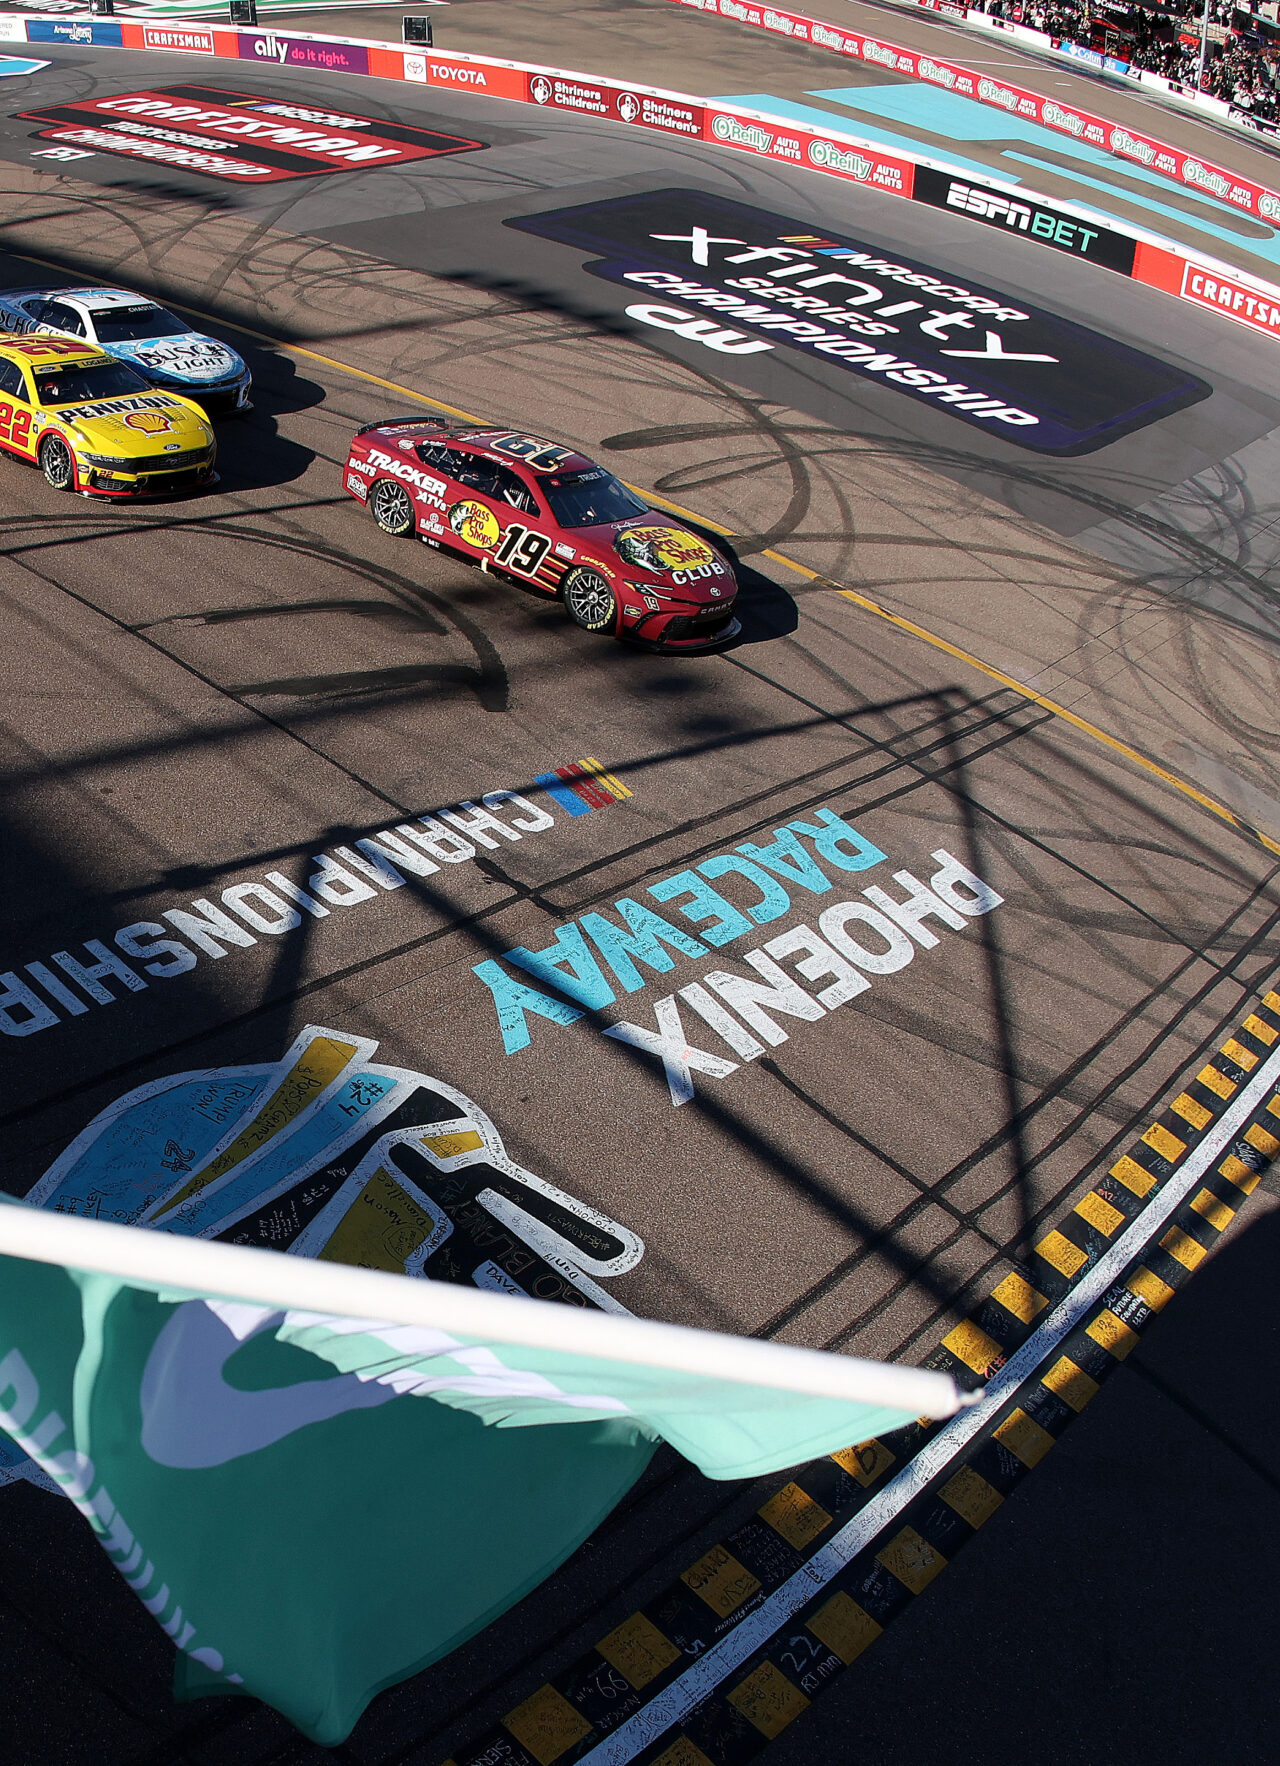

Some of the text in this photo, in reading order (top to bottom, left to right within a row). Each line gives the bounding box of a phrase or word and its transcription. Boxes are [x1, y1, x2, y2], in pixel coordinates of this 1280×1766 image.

[254, 36, 289, 64] ally
[291, 48, 349, 67] do it right.
[430, 64, 486, 86] TOYOTA
[554, 82, 601, 101] Shriners
[979, 80, 1018, 109] O'Reilly
[554, 93, 607, 114] Children's
[642, 100, 692, 120] Shriners
[1018, 106, 1037, 118] PARTS
[1020, 98, 1036, 110] AUTO
[96, 97, 402, 162] CRAFTSMAN
[642, 112, 698, 134] Children's
[1042, 104, 1084, 134] O'Reilly
[1087, 124, 1104, 135] AUTO
[713, 115, 771, 152] O'Reilly
[776, 136, 799, 149] AUTO
[1085, 131, 1104, 144] PARTS
[52, 126, 271, 177] CHAMPIONSHIP
[773, 145, 801, 160] PARTS
[1111, 130, 1155, 164] O'Reilly
[811, 140, 872, 178] O'Reilly
[1155, 161, 1176, 174] PARTS
[1158, 153, 1176, 165] AUTO
[872, 173, 902, 190] PARTS
[876, 164, 901, 178] AUTO
[1183, 160, 1230, 196] O'Reilly
[1229, 194, 1252, 208] PARTS
[1232, 185, 1251, 199] AUTO
[1031, 210, 1099, 251] BET
[832, 252, 1030, 321] NASCAR
[722, 275, 901, 337] SERIES
[134, 343, 231, 368] BUSCH
[623, 270, 1040, 427] CHAMPIONSHIP
[174, 356, 226, 373] LIGHT
[56, 395, 184, 424] PENNZOIL
[348, 458, 377, 477] BOATS
[367, 449, 448, 498] TRACKER
[415, 491, 447, 512] ATVs
[471, 503, 490, 522] Bass
[470, 517, 484, 530] Pro
[468, 527, 493, 546] Shops
[630, 528, 673, 542] Bass
[494, 523, 552, 578] 19
[671, 562, 725, 585] CLUB
[643, 596, 660, 611] 19
[471, 808, 889, 1055] RACEWAY
[601, 849, 1005, 1107] PHOENIX
[339, 1081, 384, 1117] #24
[160, 1139, 196, 1172] 24
[1103, 1286, 1126, 1308] SEAL
[779, 1635, 822, 1672] 22
